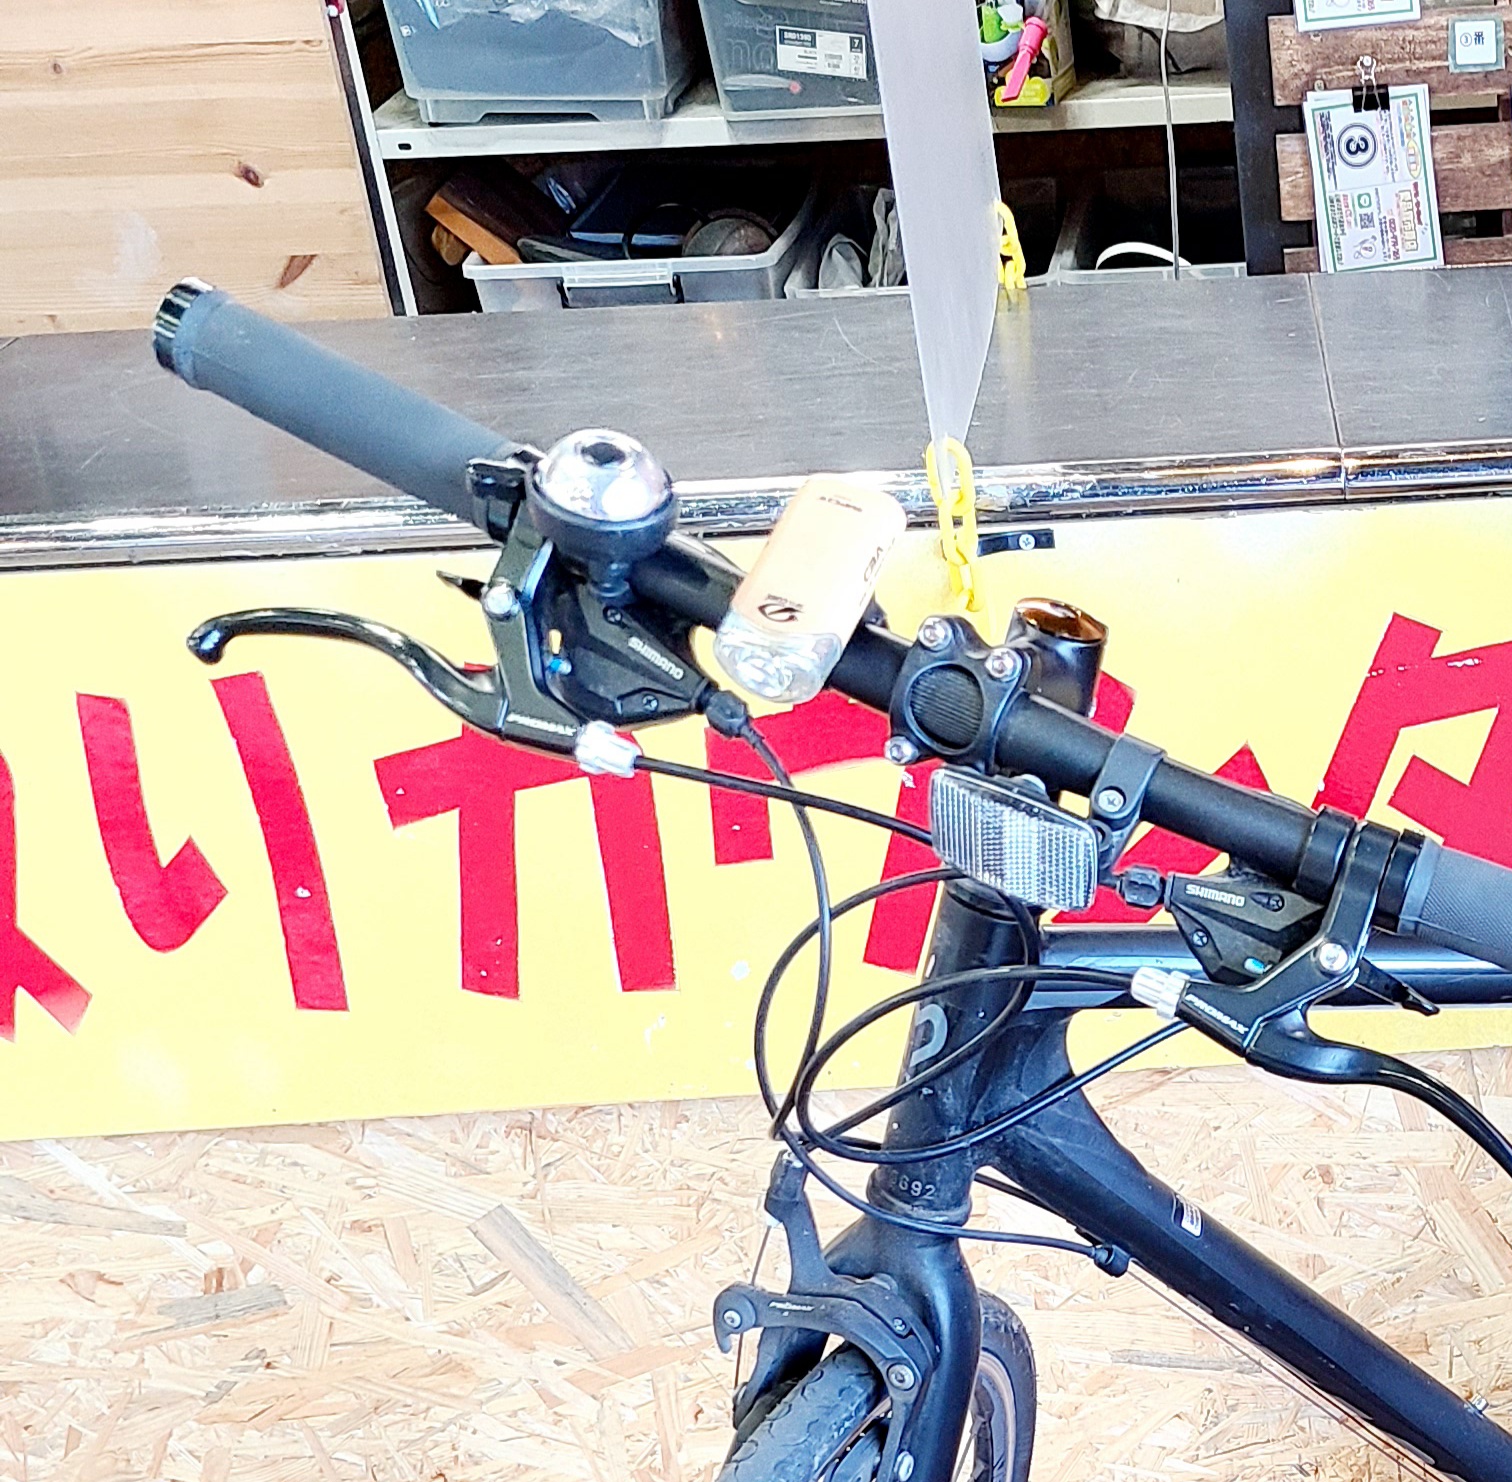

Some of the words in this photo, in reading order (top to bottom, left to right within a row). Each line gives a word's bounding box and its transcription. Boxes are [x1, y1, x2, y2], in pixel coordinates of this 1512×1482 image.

[627, 636, 684, 681] SHIMANO
[506, 711, 577, 736] PROMAX
[1186, 883, 1245, 907] SHIMANO
[1184, 993, 1248, 1036] PROMAX
